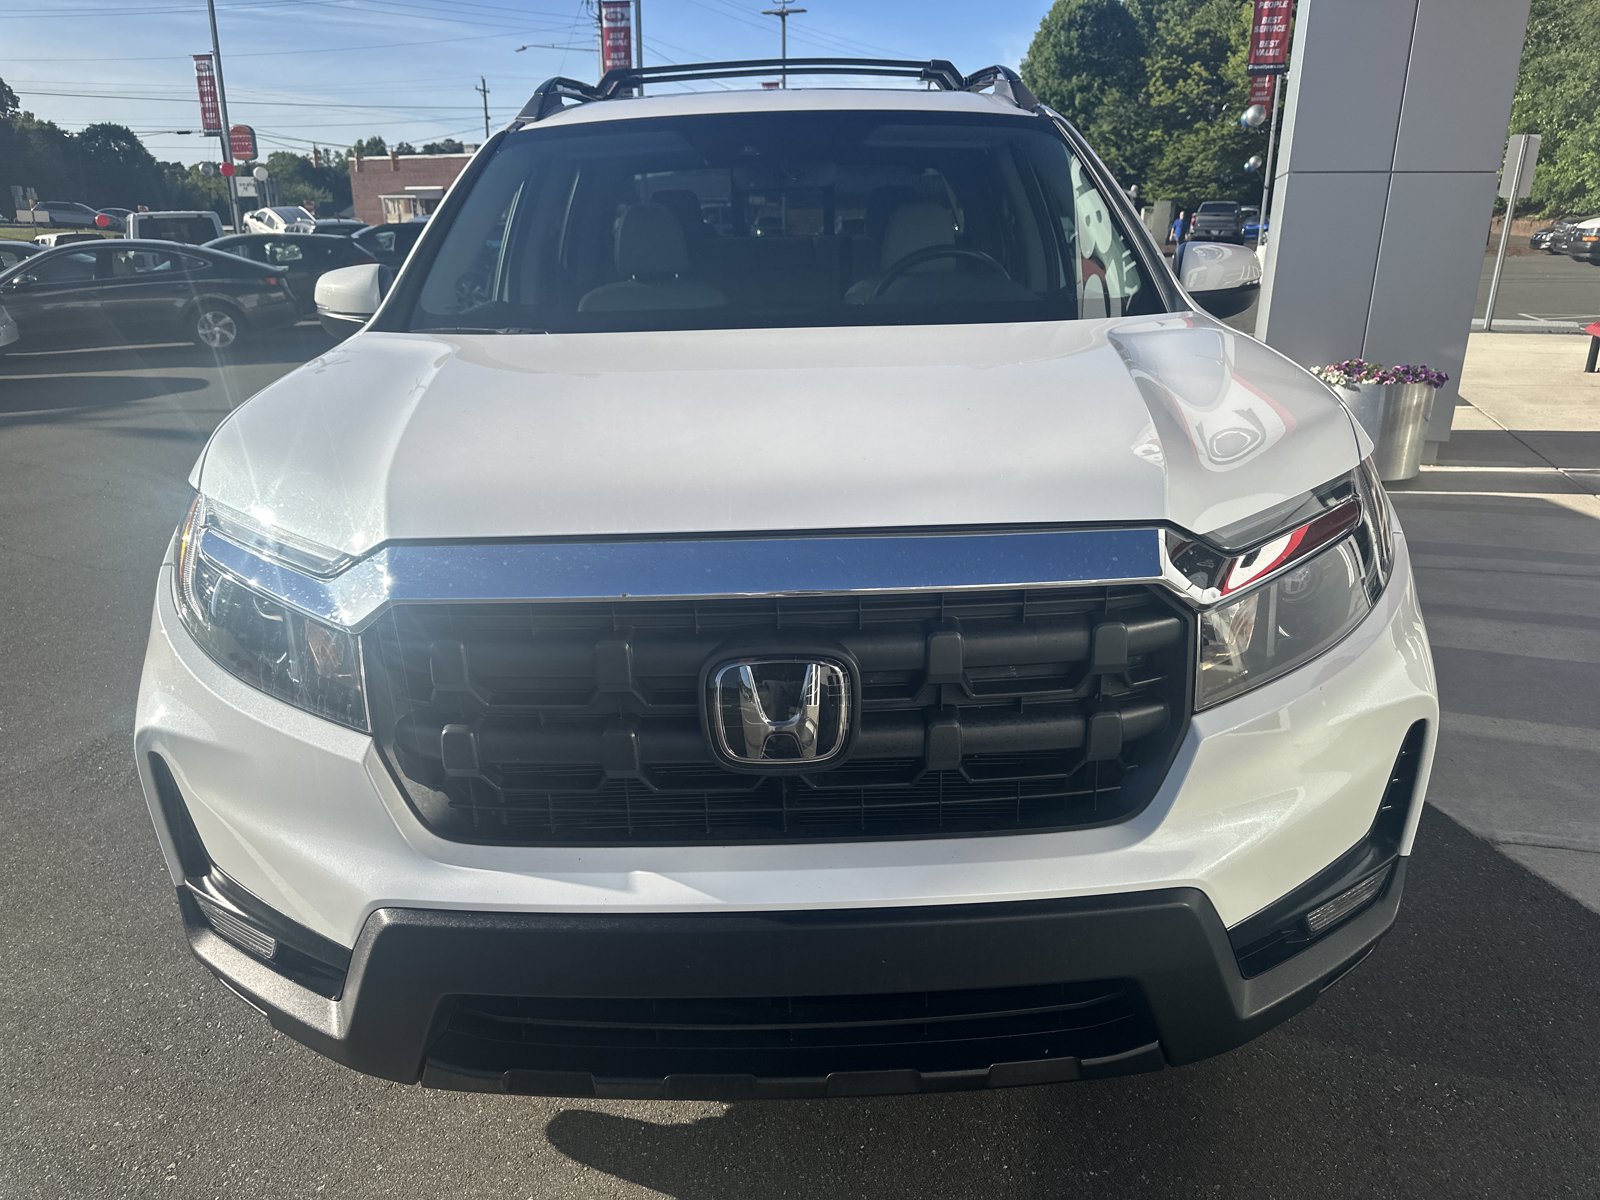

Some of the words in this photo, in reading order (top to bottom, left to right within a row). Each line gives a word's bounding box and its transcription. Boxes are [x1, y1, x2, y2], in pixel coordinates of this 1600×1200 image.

[1258, 0, 1288, 9] PEOPLE
[1261, 16, 1283, 24] BEST
[1254, 25, 1287, 33] SERVICE
[1258, 40, 1280, 48] BEST
[1256, 48, 1280, 56] VALUE
